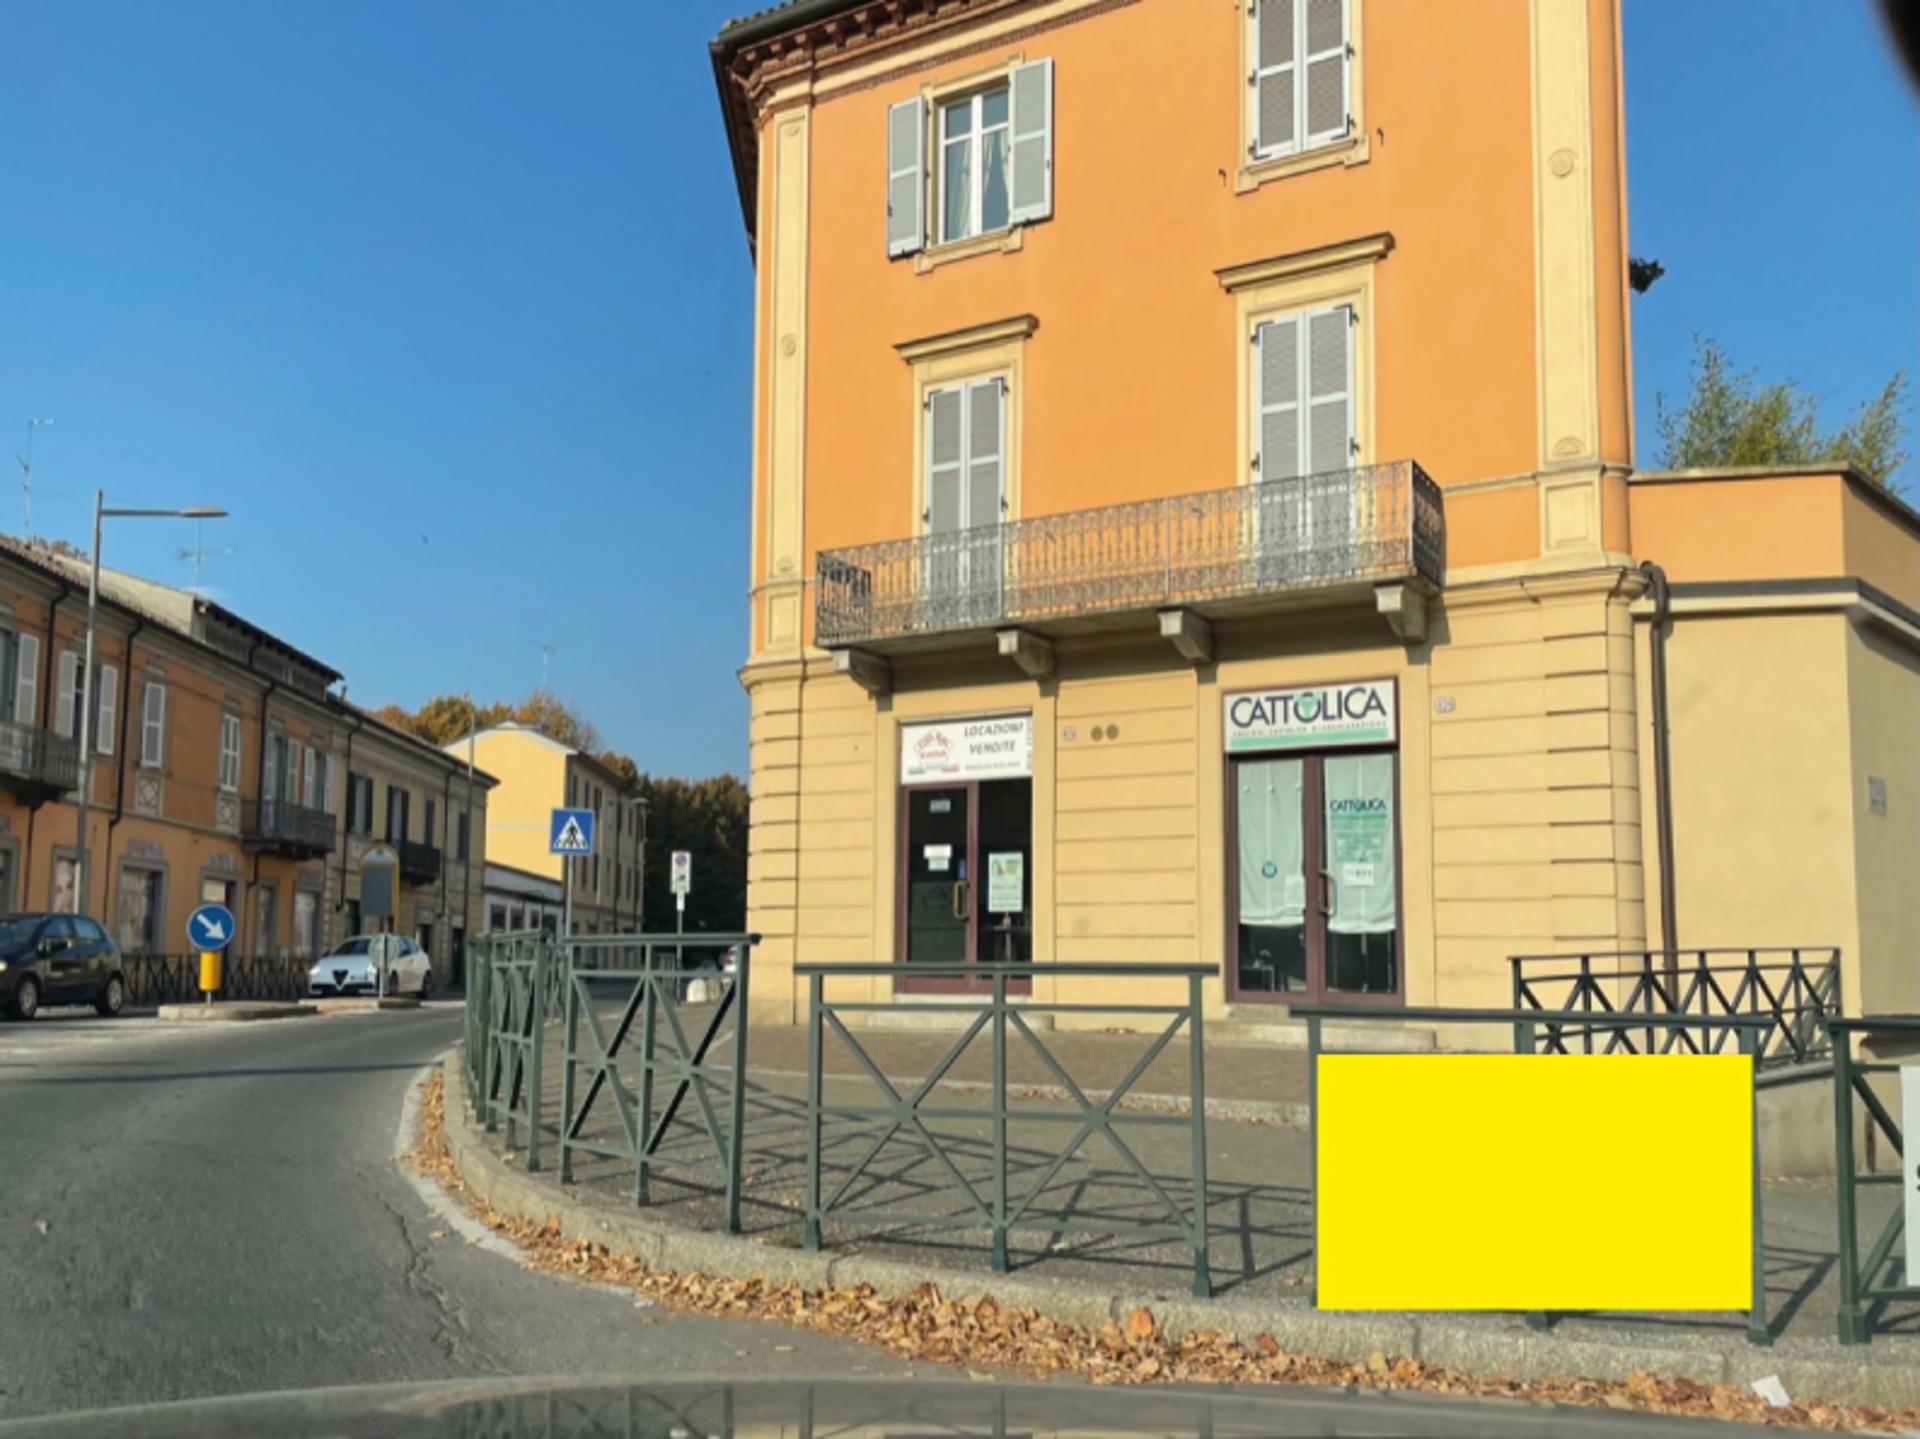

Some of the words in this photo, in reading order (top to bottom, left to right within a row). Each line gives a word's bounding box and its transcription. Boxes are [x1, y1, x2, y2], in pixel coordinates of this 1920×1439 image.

[1230, 687, 1387, 728] CATTOLICA
[964, 721, 1024, 737] LOCAZIONI
[969, 740, 1015, 754] VENDITE
[1331, 798, 1386, 812] CATTOLICA
